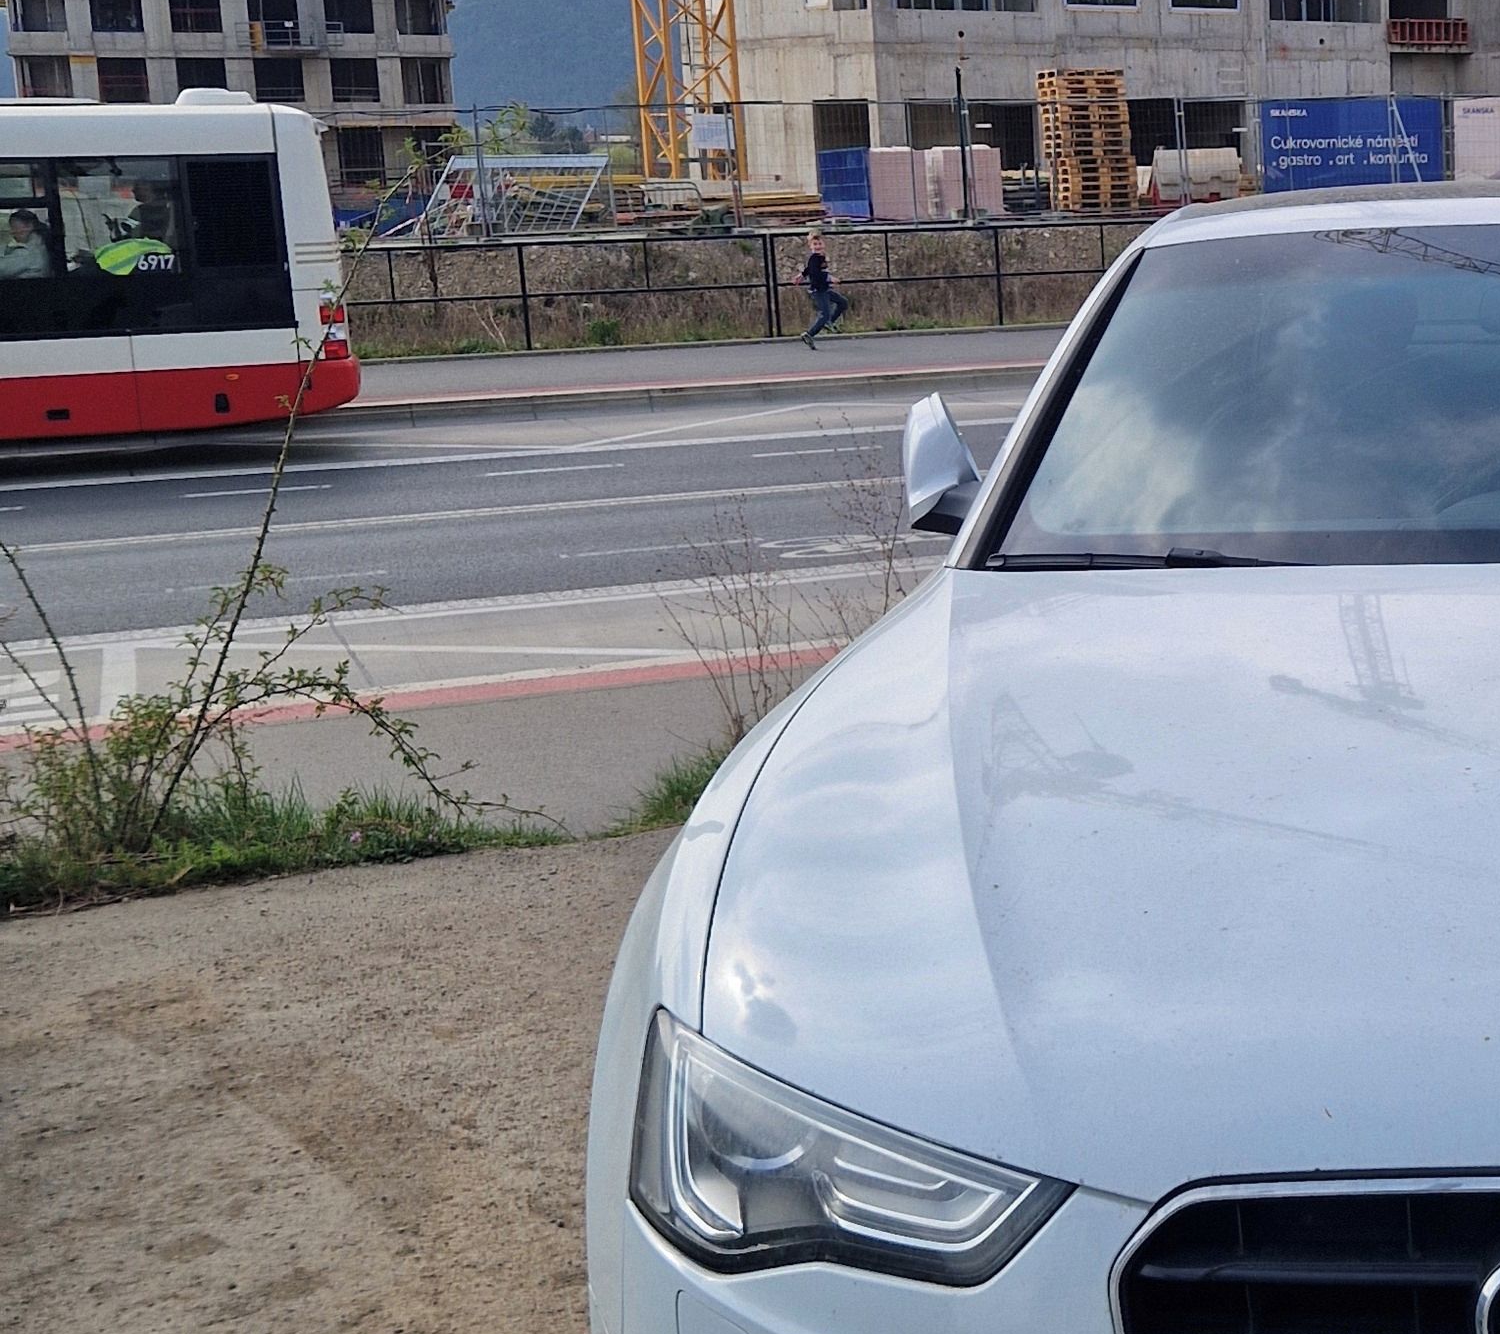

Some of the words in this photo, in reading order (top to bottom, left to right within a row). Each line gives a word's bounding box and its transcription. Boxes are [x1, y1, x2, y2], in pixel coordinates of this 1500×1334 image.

[1270, 109, 1307, 117] SKANSKA
[1462, 107, 1495, 115] SKANSKA
[1271, 134, 1364, 149] Cukrovarnické
[138, 254, 175, 271] 6917
